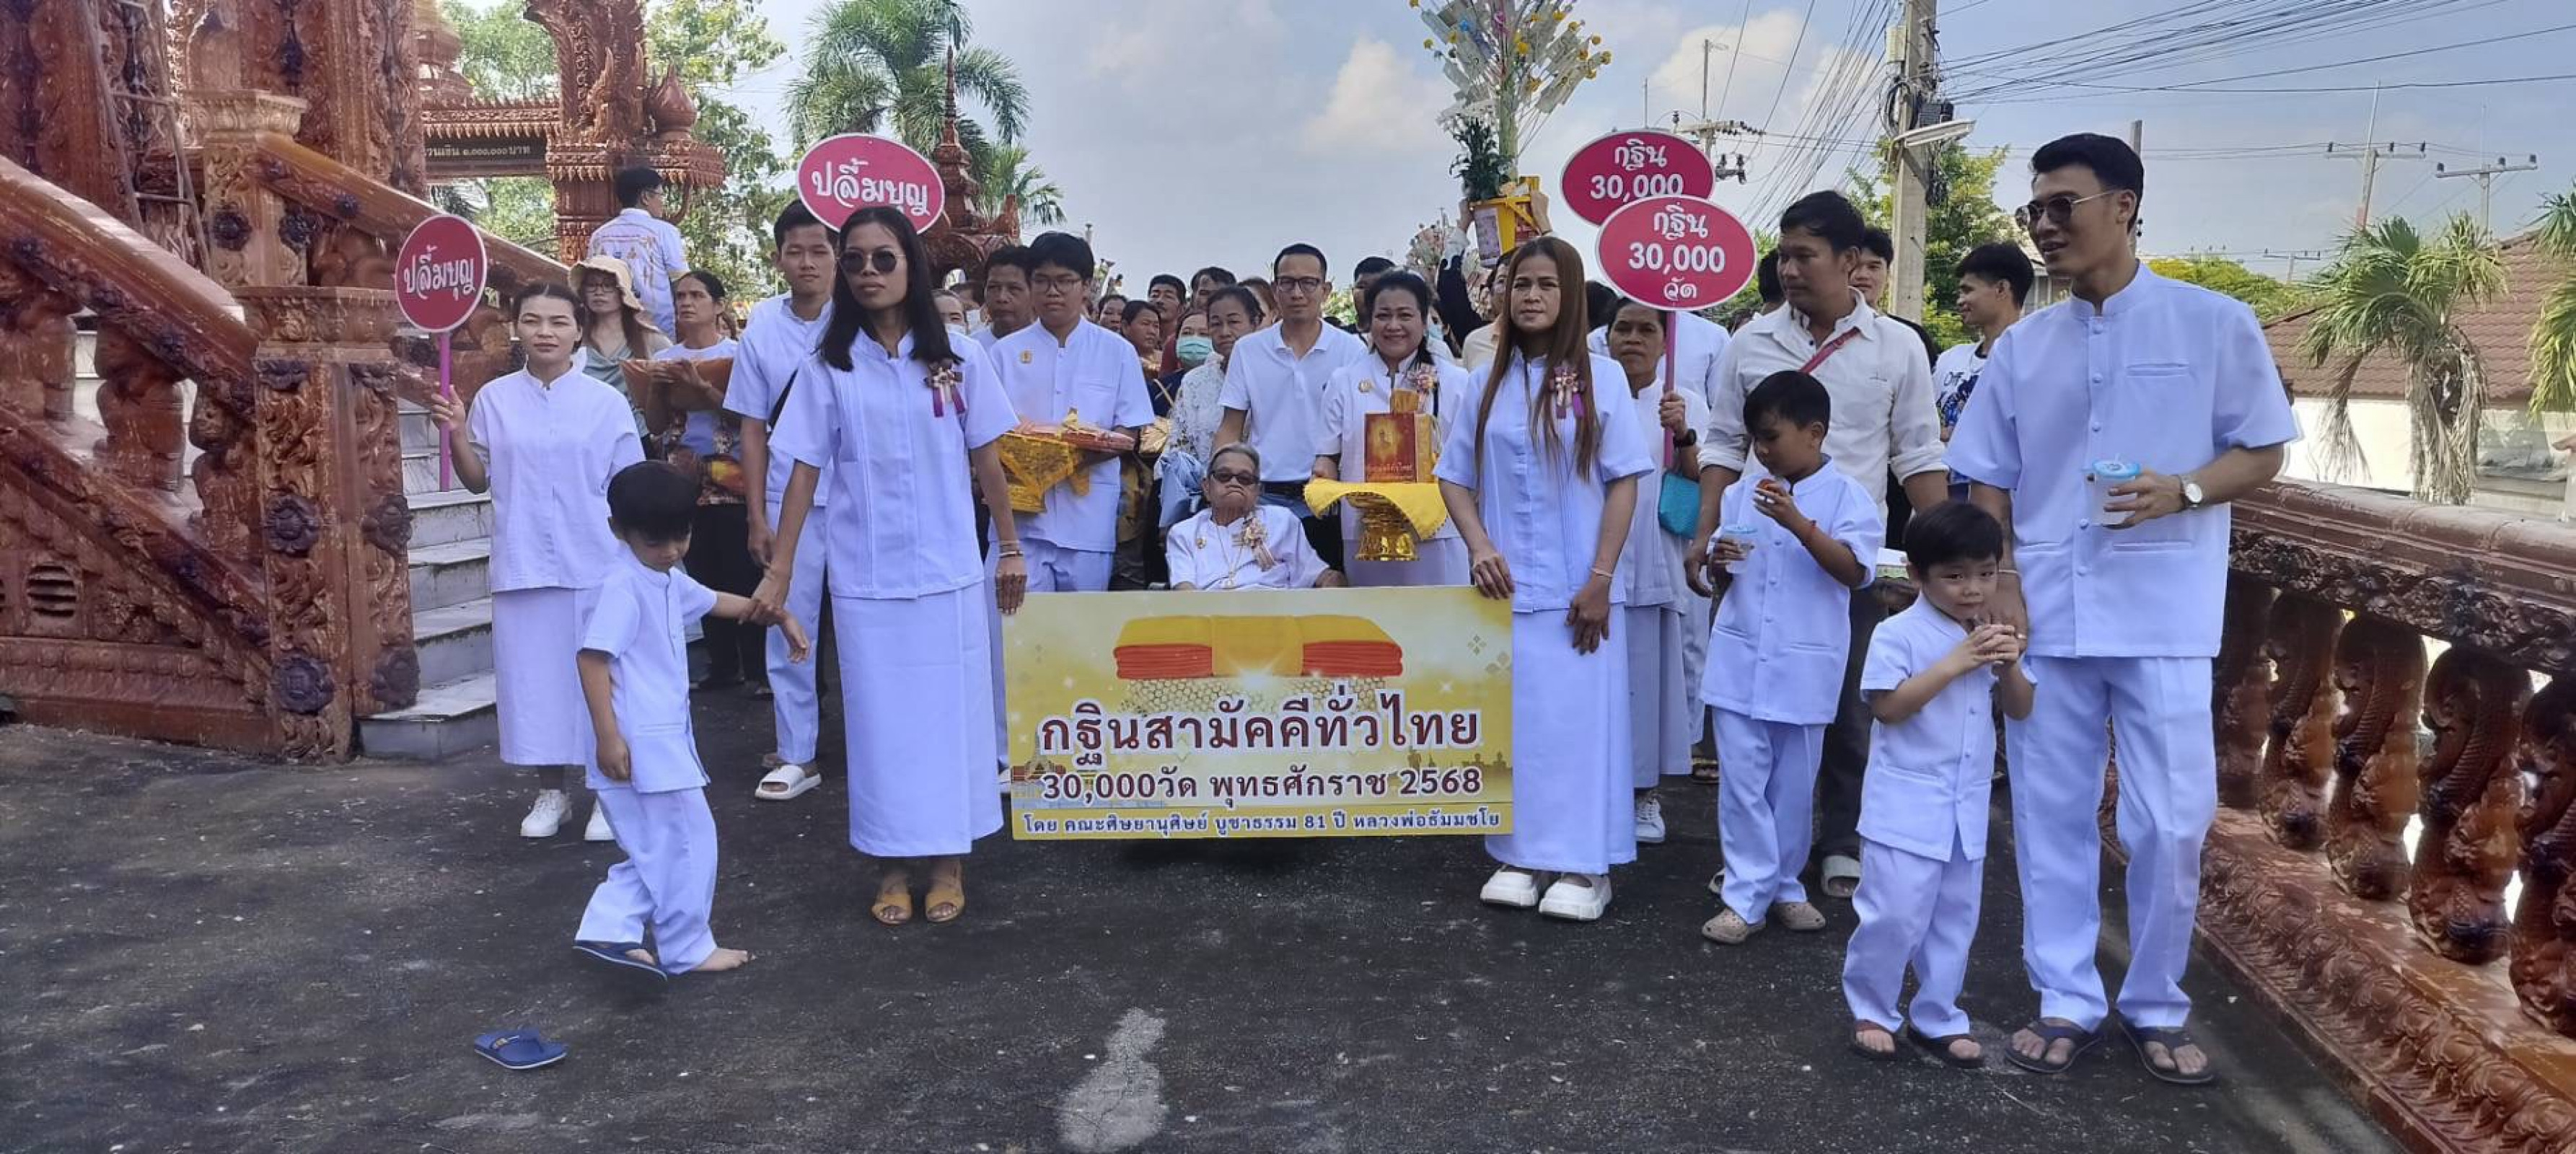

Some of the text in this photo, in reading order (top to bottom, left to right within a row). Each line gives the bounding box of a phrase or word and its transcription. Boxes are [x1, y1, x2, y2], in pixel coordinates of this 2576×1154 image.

[1614, 138, 1668, 171] กฐิน
[811, 157, 931, 216] ปลื้มบุญ
[1590, 174, 1684, 203] 30,000
[1653, 204, 1709, 241] กฐิน
[403, 244, 476, 301] ปลื้มบุญ
[1628, 242, 1726, 276] 30,000
[1663, 276, 1698, 301] วัด
[1042, 684, 1478, 766] กฐินสามัคคีทั่วไทย
[1043, 763, 1482, 808] 30,000วัด พุทธศักราช 2568
[1024, 807, 1500, 835] โดย คณะศิษยานุศิษย์ บูชาธรรม 81 ปี หลวงพ่อธัมมชโย
